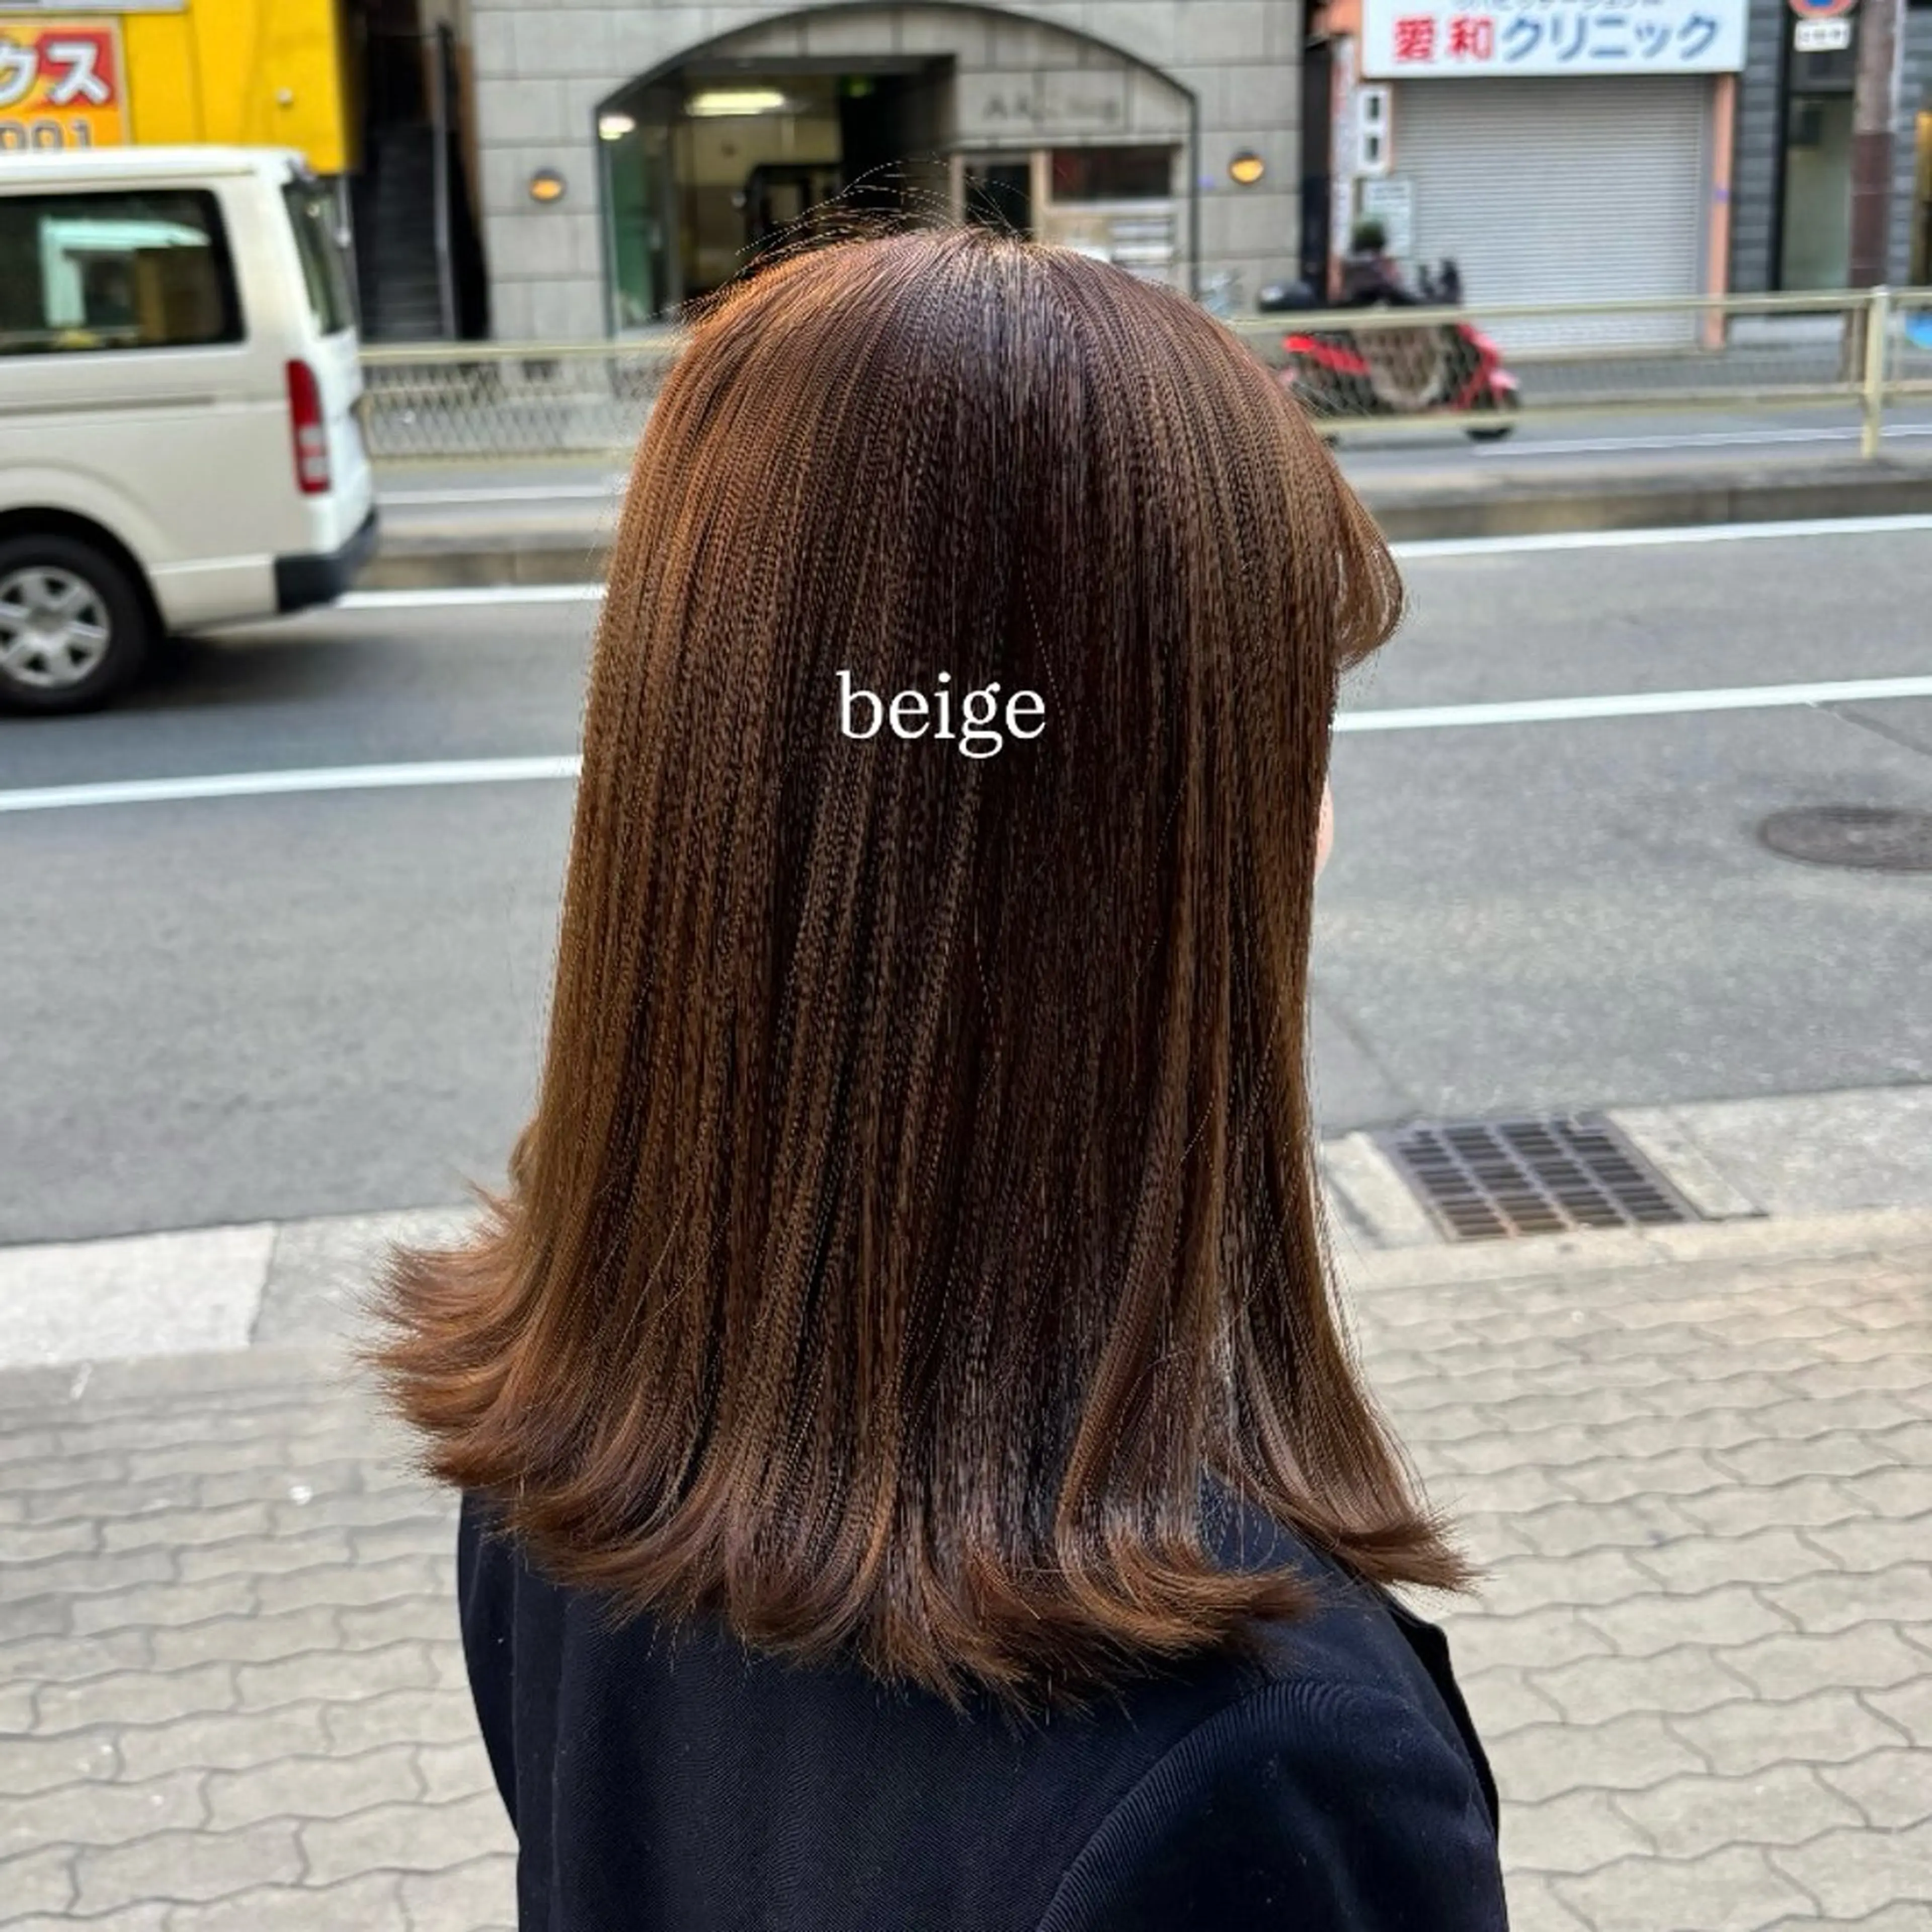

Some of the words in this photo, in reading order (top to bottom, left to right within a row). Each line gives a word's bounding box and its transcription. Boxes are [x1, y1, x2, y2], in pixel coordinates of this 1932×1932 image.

[1394, 15, 1719, 62] 愛和クリニック
